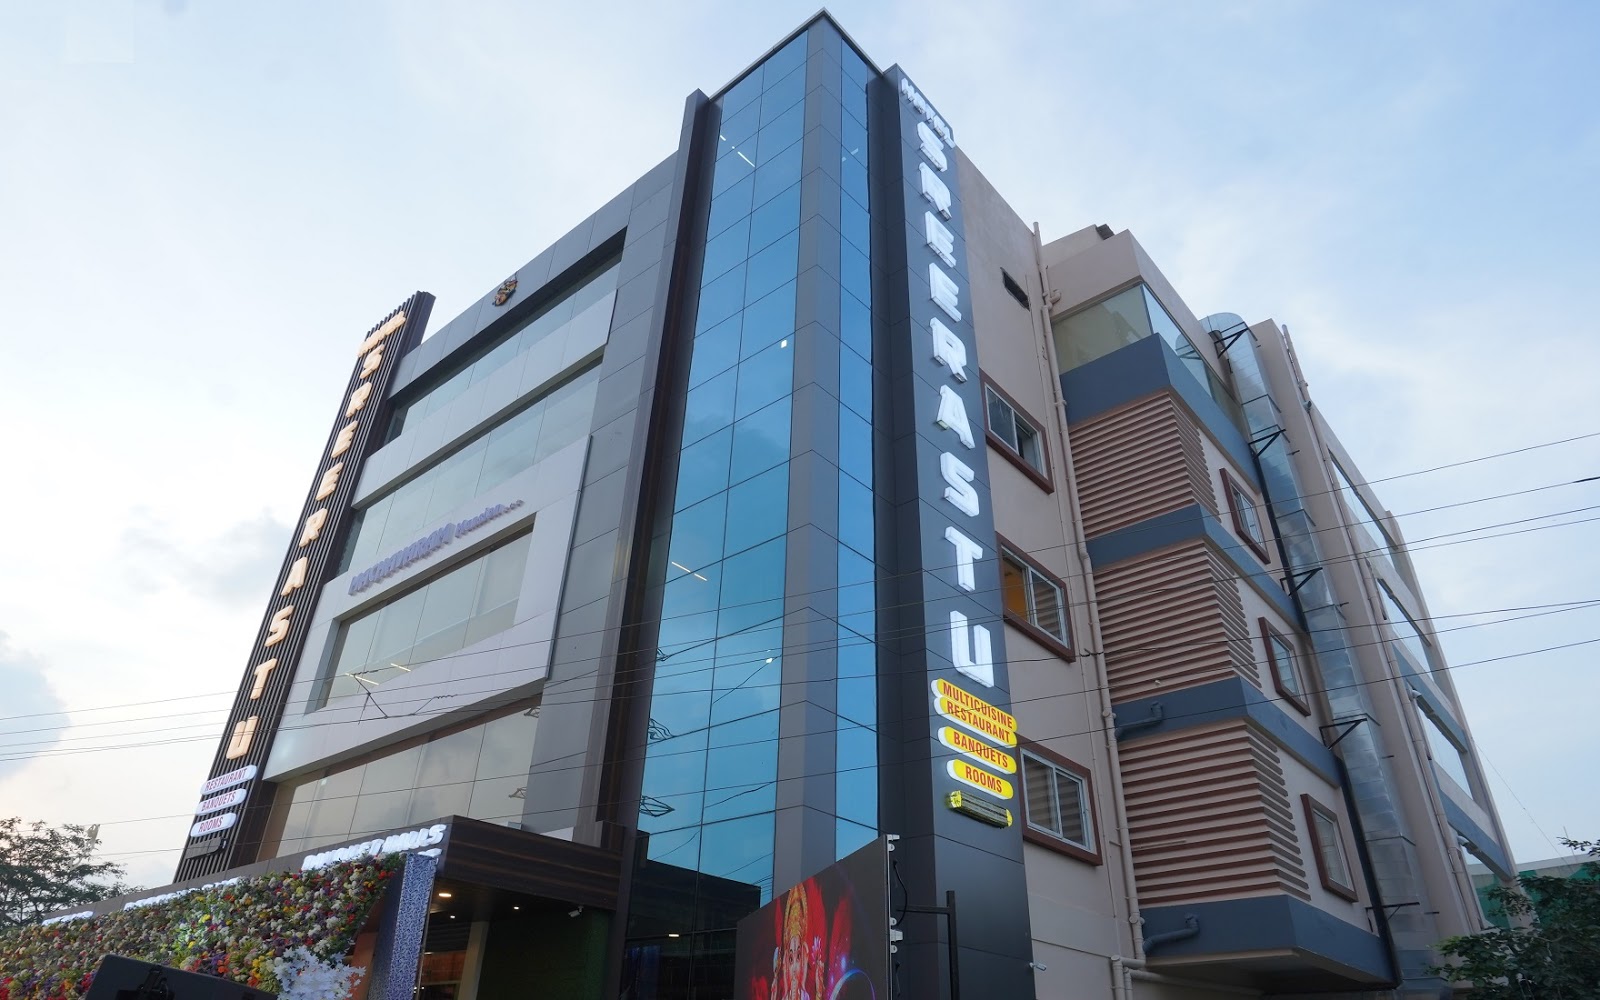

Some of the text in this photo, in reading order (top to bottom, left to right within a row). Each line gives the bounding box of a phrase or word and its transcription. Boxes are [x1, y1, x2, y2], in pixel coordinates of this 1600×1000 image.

[916, 121, 994, 688] SREERASTU
[225, 343, 386, 760] SREERASTU
[943, 682, 1013, 730] MULTICUISINE
[946, 700, 1011, 743] RESTAURANT
[954, 731, 1009, 768] BANQUETS
[205, 767, 248, 791] RESTAURANT
[965, 765, 1003, 793] ROOMS
[201, 791, 237, 812] BANQUETS
[198, 816, 224, 833] ROOMS
